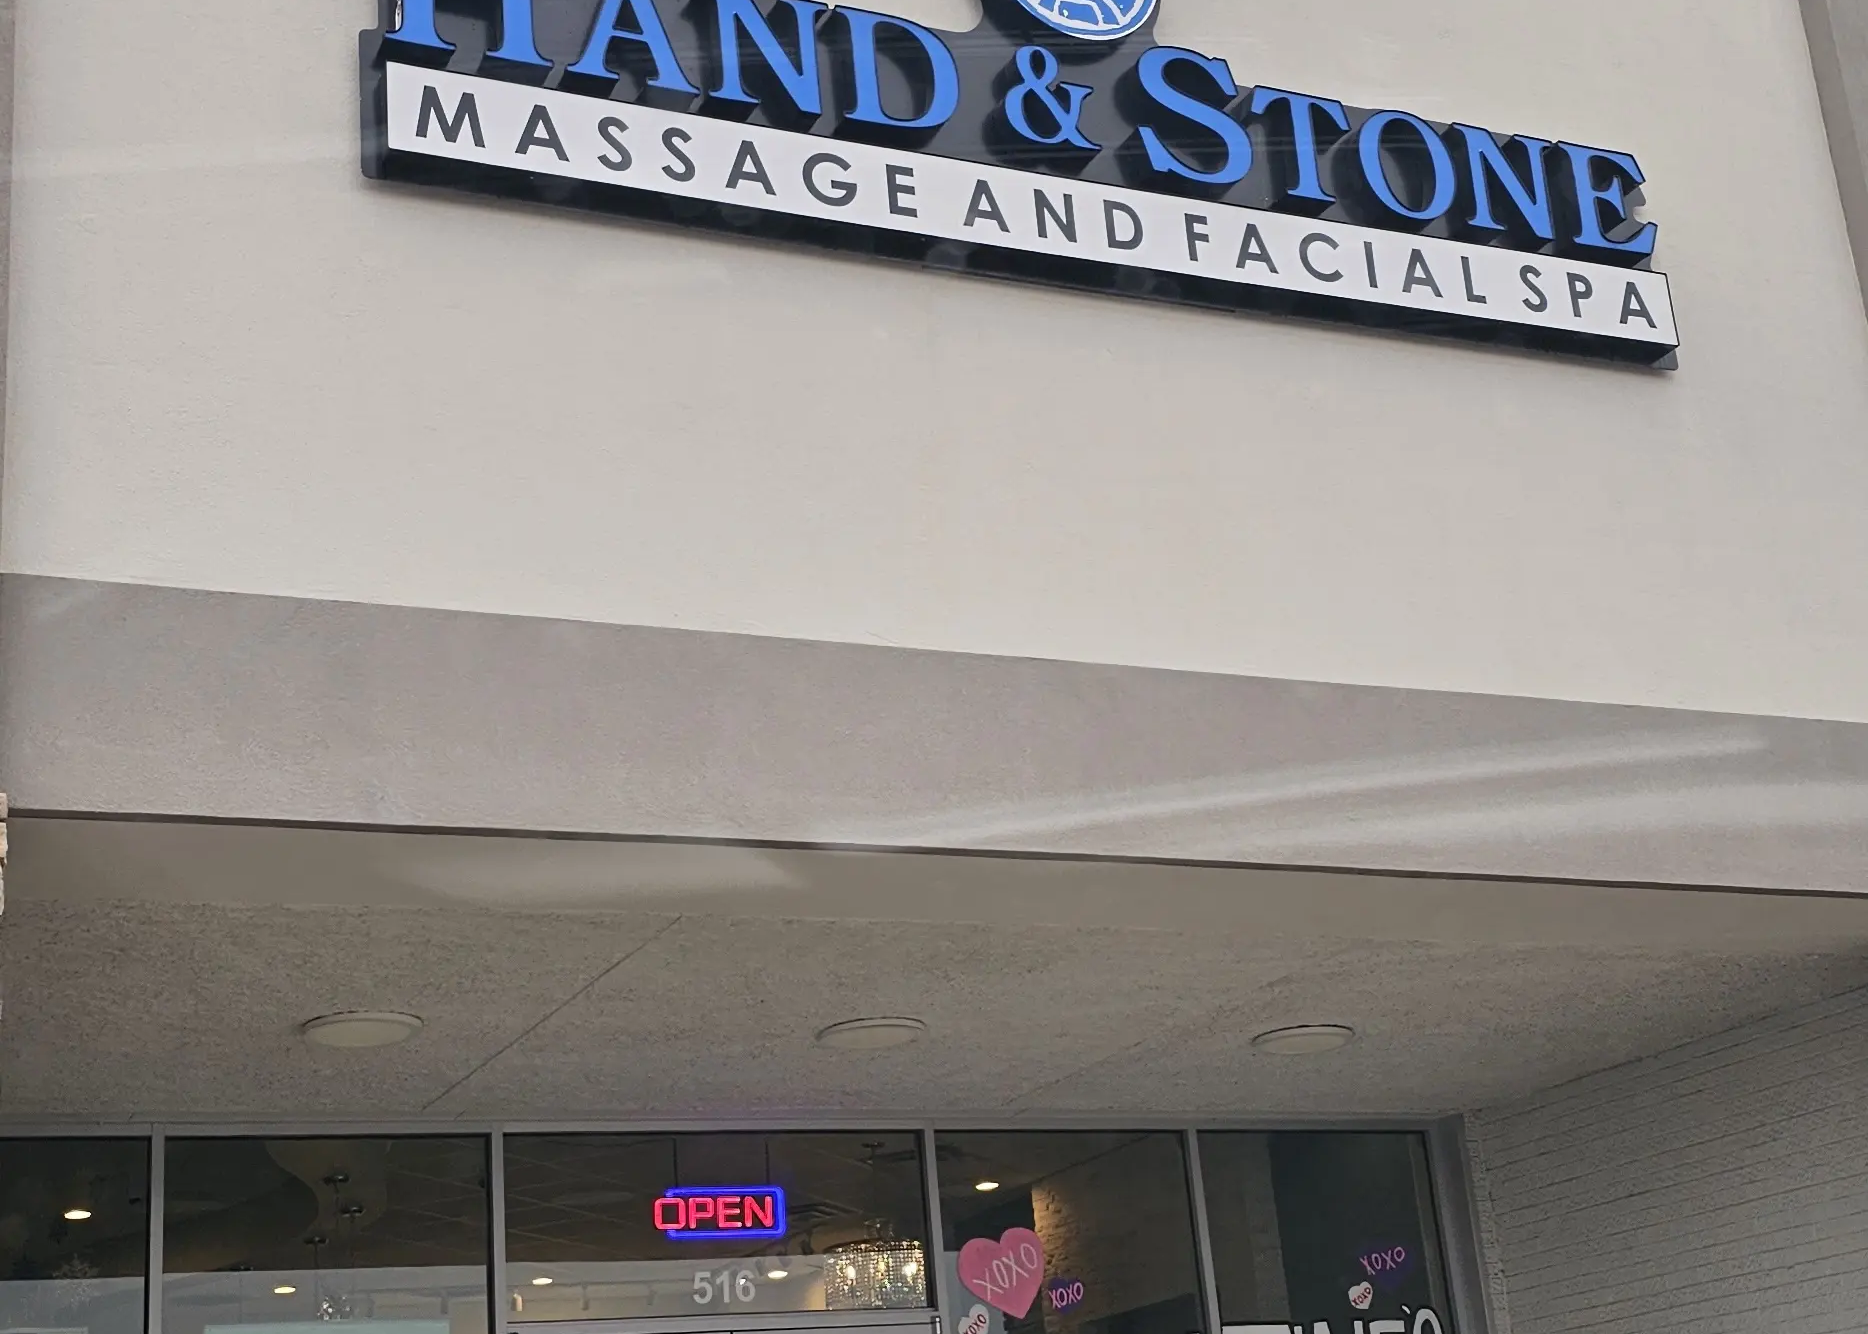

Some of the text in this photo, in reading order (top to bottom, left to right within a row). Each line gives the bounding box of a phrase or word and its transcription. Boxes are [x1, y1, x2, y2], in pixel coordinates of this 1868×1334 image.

[1003, 45, 1101, 149] &
[1138, 45, 1658, 254] STONE
[416, 85, 1656, 328] MASSAGE AND FACIAL SPA
[654, 1195, 774, 1230] OPEN
[972, 1243, 1037, 1301] XOXO
[1360, 1246, 1405, 1275] XOXO
[693, 1269, 756, 1304] 516
[1049, 1282, 1084, 1309] XOXO
[1352, 1286, 1371, 1306] XOXO
